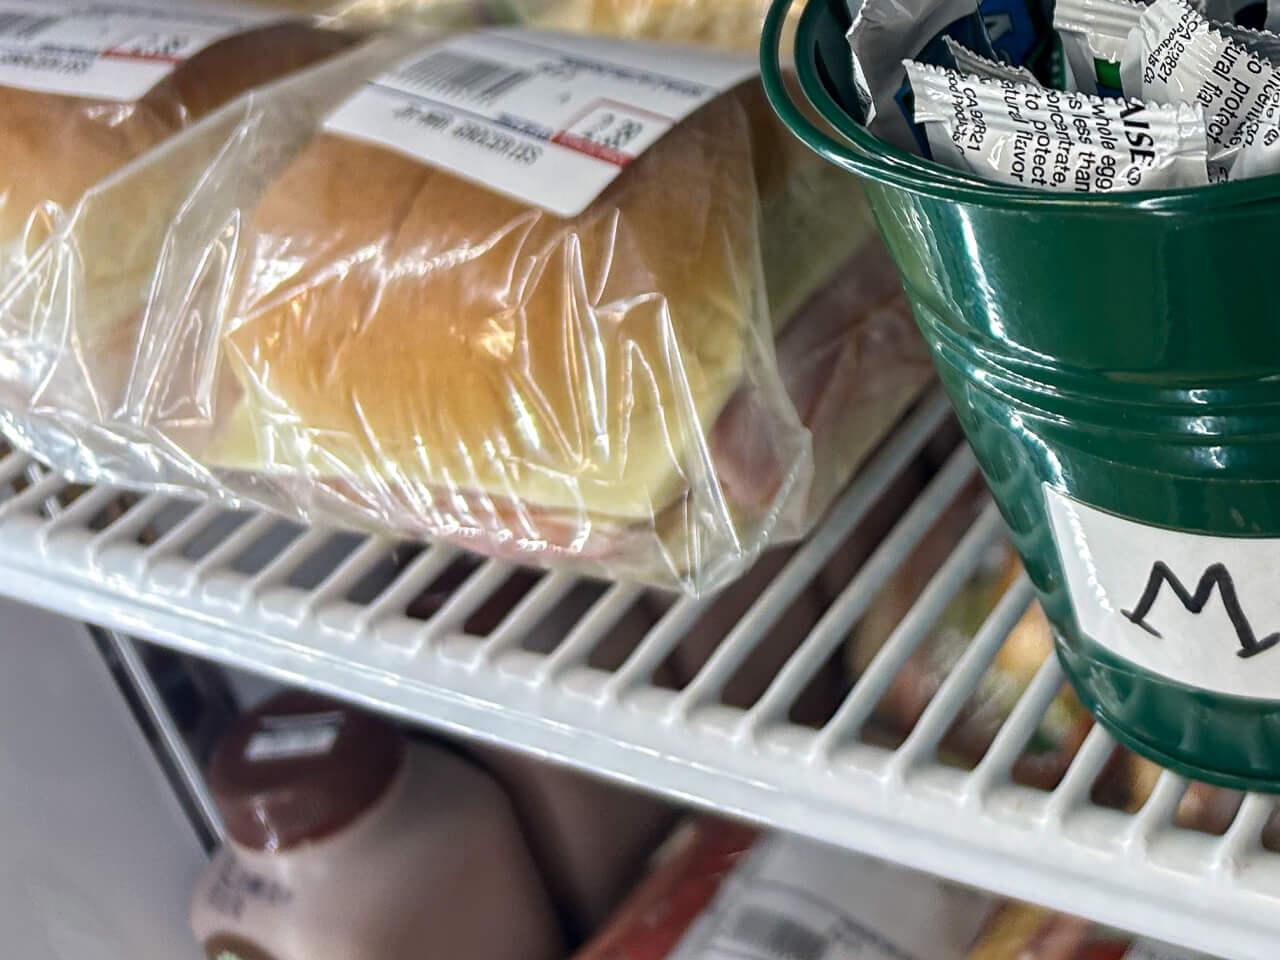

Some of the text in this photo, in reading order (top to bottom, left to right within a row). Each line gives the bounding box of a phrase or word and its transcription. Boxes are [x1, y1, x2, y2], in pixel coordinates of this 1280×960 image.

[963, 87, 978, 108] CA
[1207, 77, 1250, 145] protect
[1025, 91, 1053, 188] to protect
[1072, 114, 1092, 145] less
[1091, 102, 1118, 151] whole
[1009, 129, 1034, 183] flavor
[1074, 151, 1096, 193] than
